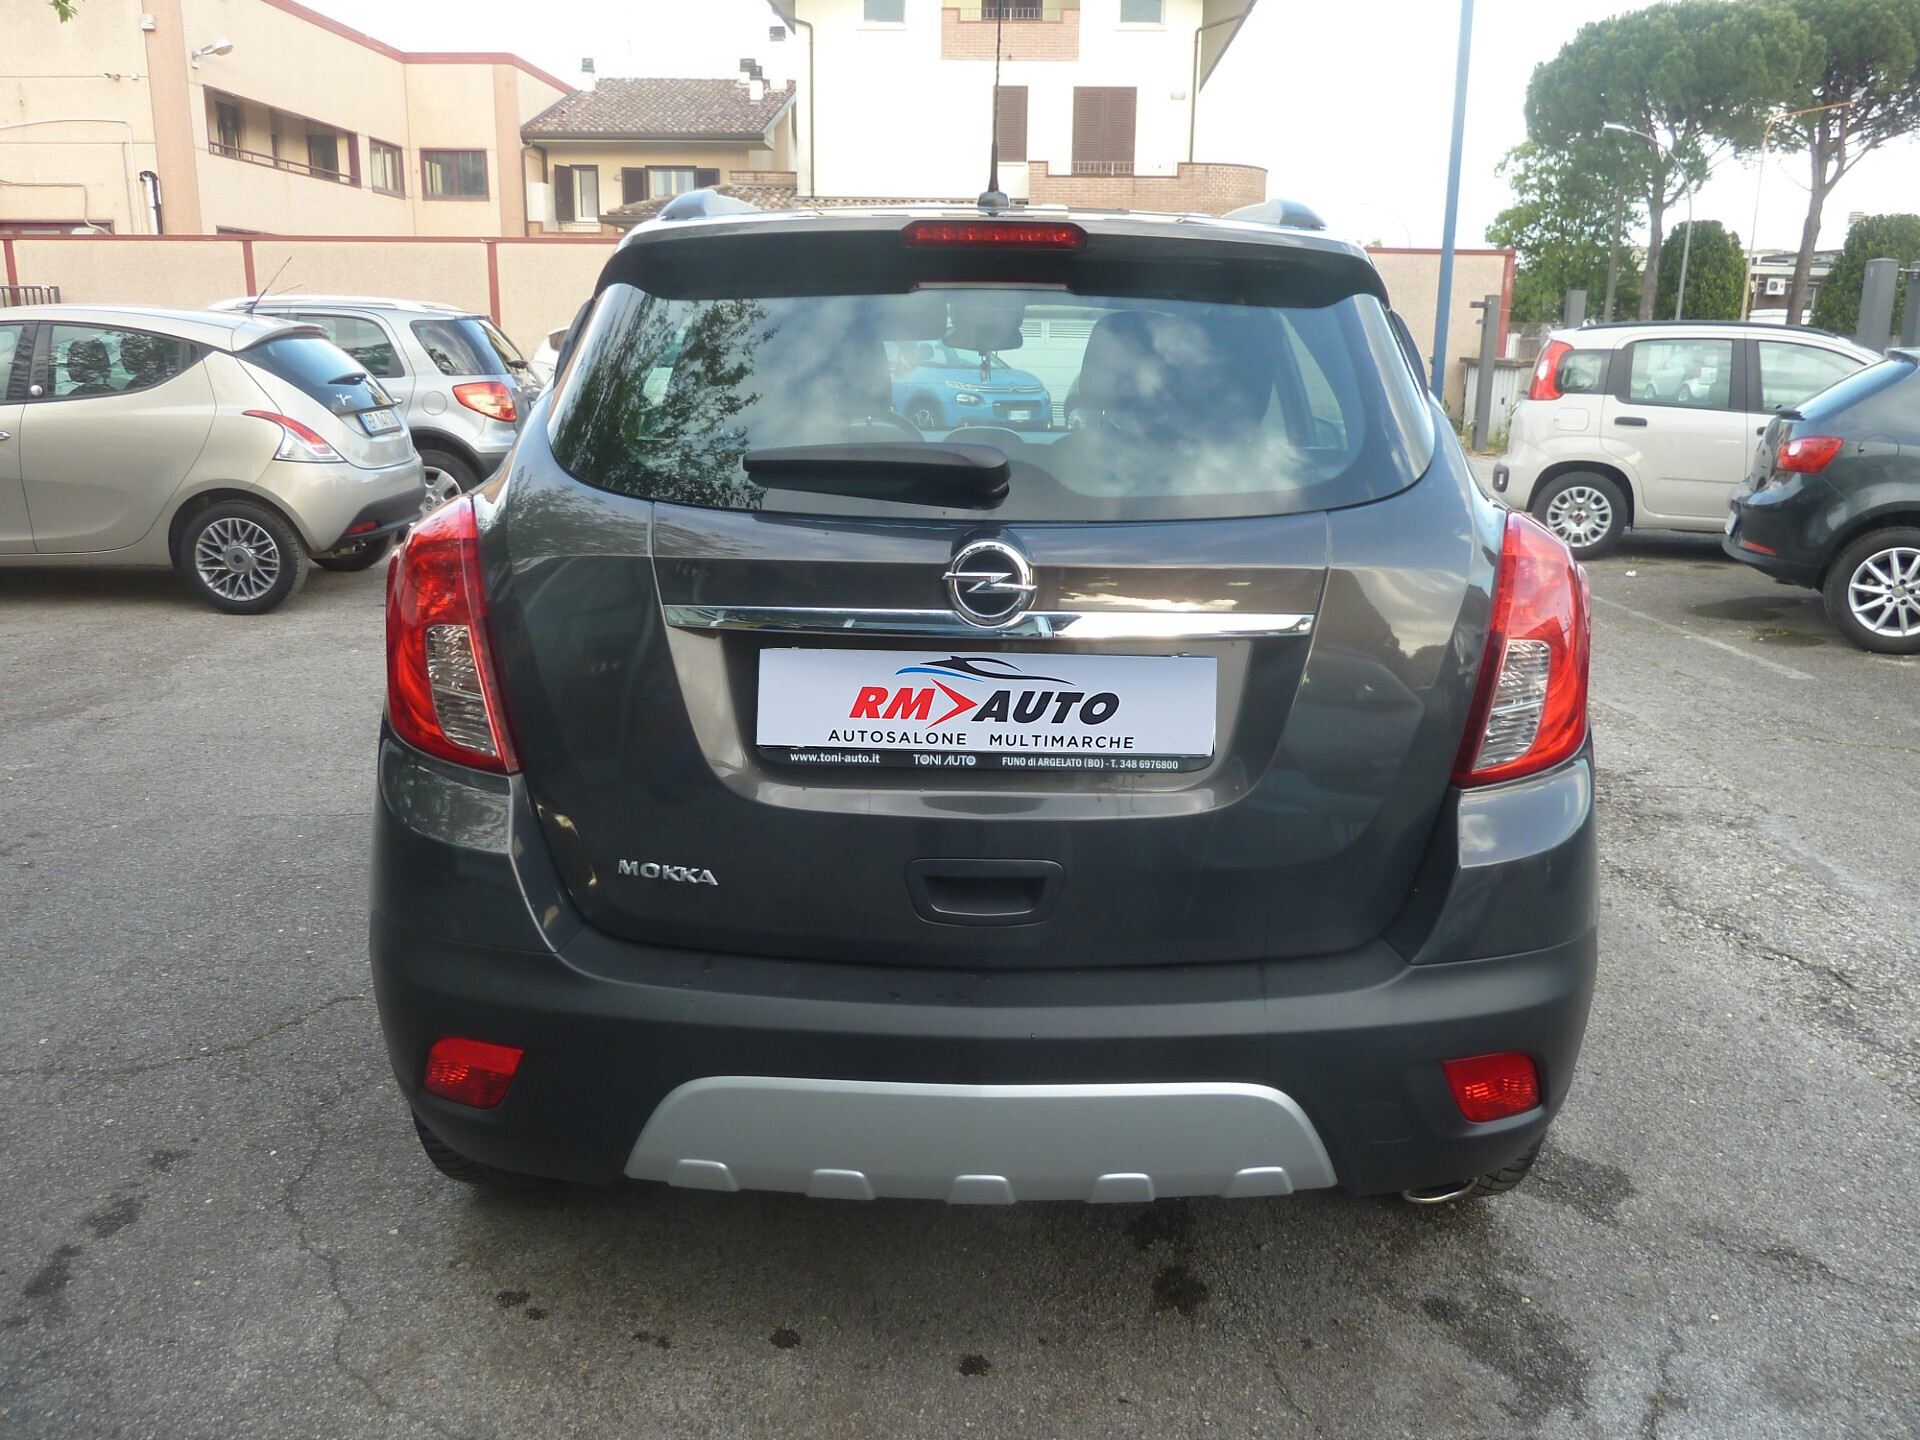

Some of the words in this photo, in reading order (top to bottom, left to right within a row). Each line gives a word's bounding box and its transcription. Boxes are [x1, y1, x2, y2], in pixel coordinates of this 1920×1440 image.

[849, 686, 936, 720] RM
[971, 690, 1120, 725] AUTO
[828, 729, 967, 745] AUTOSALONE
[989, 733, 1134, 749] MULTIMARCHE
[790, 752, 880, 764] www.toni-auto.it
[913, 754, 942, 765] TONI
[943, 755, 976, 766] AUTO
[1002, 757, 1026, 766] FUNO
[1027, 757, 1036, 767] di
[1037, 758, 1082, 768] ARGELATO
[1083, 758, 1104, 769] (BO)
[1111, 759, 1119, 768] T.
[1120, 759, 1137, 769] 348
[1139, 760, 1179, 770] 6976800
[618, 858, 719, 886] MOKKA
